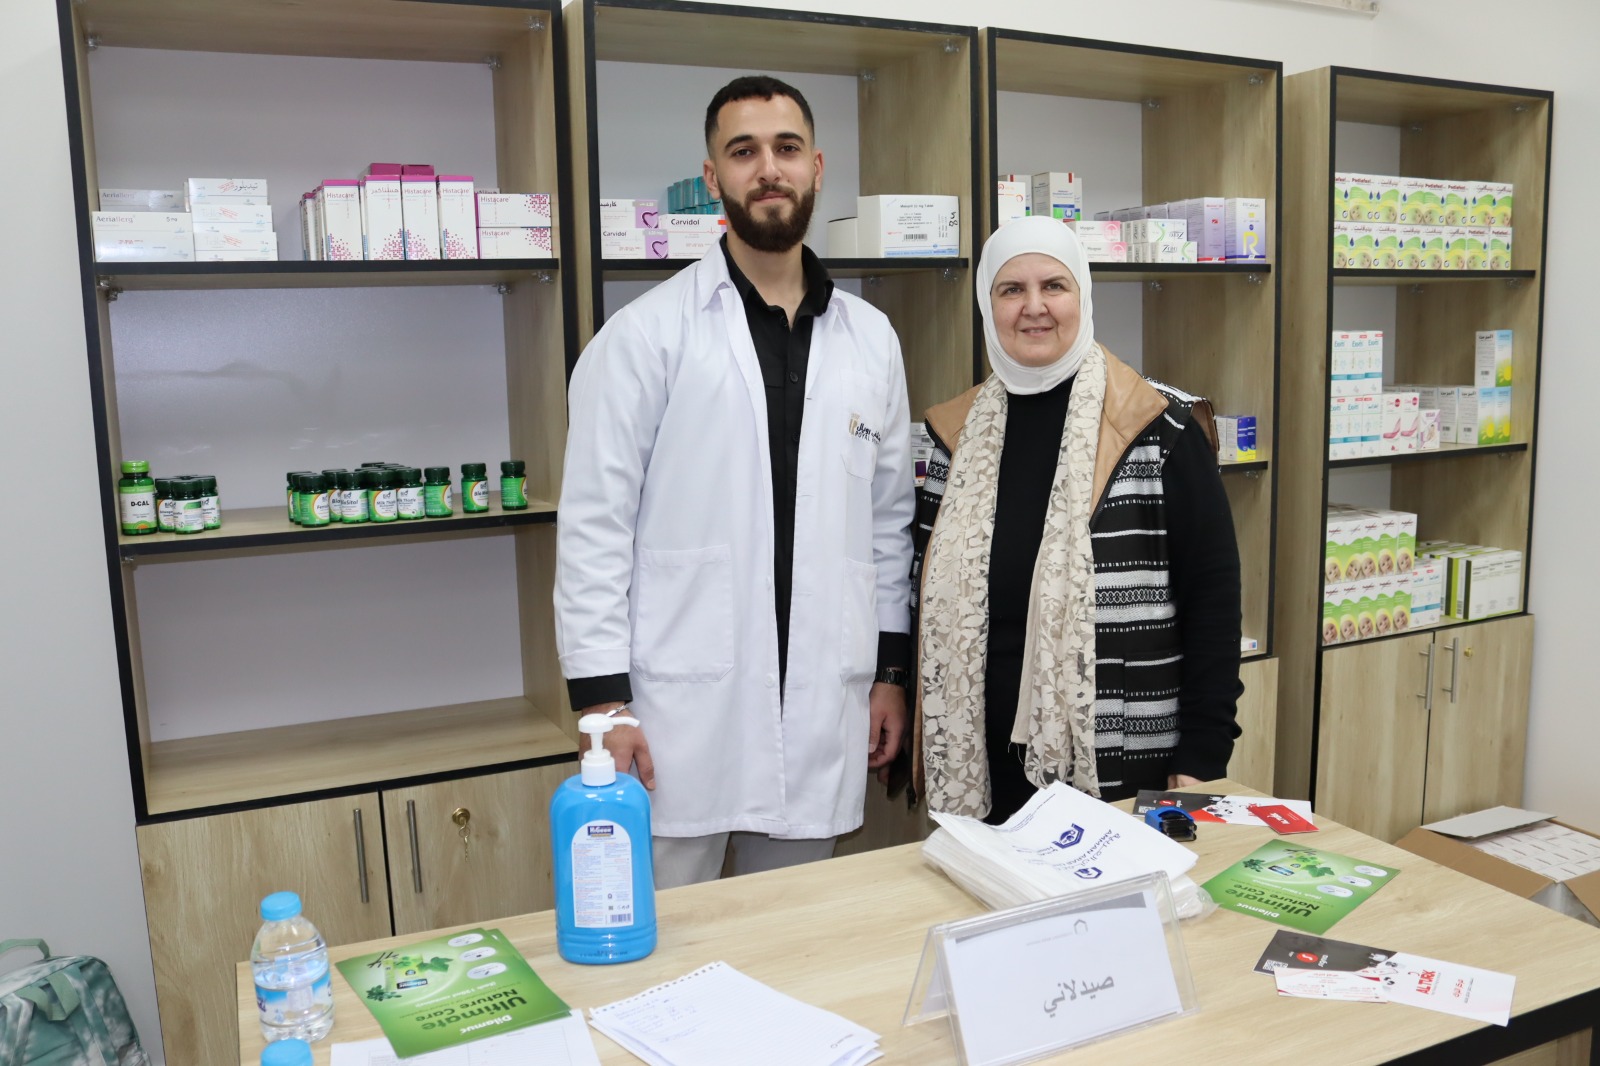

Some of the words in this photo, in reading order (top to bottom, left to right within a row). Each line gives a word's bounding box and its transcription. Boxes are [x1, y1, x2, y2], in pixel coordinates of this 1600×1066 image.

[670, 218, 700, 226] Carvidol
[1233, 884, 1265, 896] Care
[1225, 889, 1312, 917] Ultimate
[1237, 902, 1280, 918] Dilamuc
[1270, 894, 1320, 910] Nature
[460, 989, 518, 1009] Nature
[1043, 975, 1115, 1018] صيدلاني
[415, 1008, 455, 1021] Care
[421, 996, 528, 1030] Ultimate
[460, 1014, 512, 1034] Dilamuc
